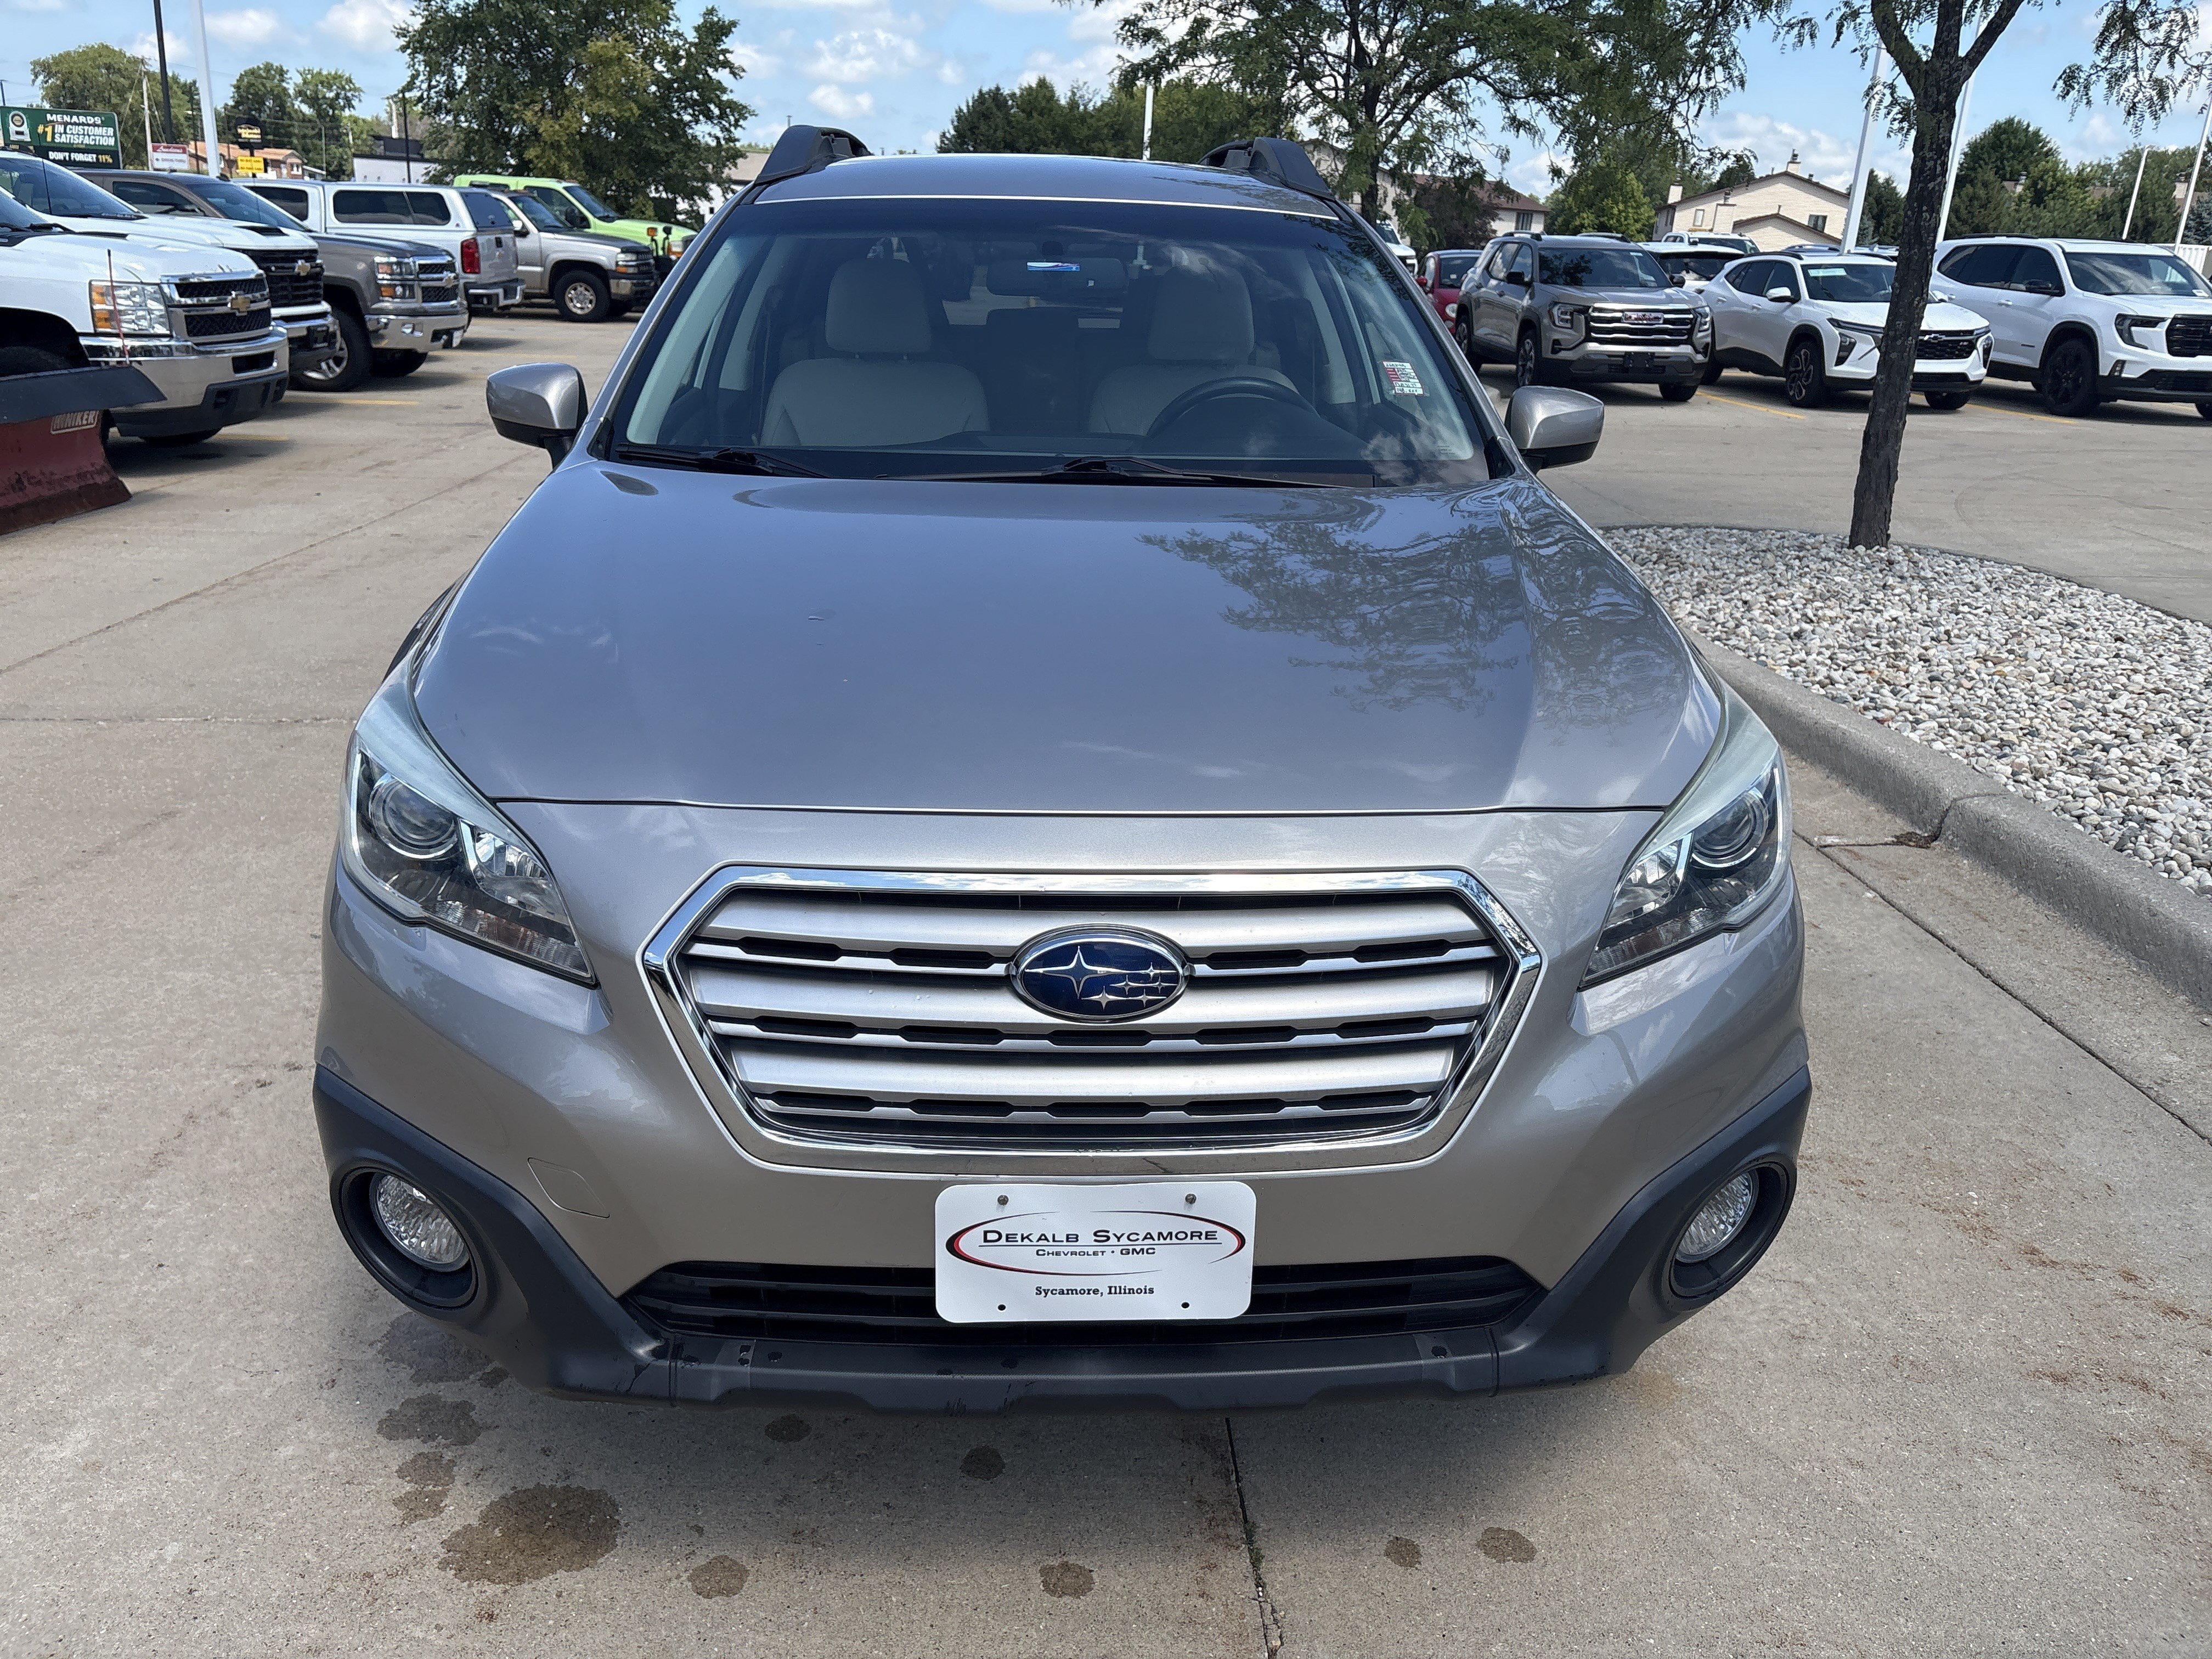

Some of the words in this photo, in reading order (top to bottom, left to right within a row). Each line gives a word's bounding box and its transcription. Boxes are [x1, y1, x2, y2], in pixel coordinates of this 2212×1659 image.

[46, 114, 101, 125] MENARDS
[37, 124, 53, 143] #1
[55, 125, 64, 133] IN
[66, 125, 114, 136] CUSTOMER
[54, 134, 115, 146] SATISFACTION
[48, 151, 70, 161] DON'T
[71, 151, 97, 163] FORGET
[98, 154, 113, 163] 11%
[983, 1229, 1079, 1243] DEKALB
[1093, 1229, 1218, 1243] SYCAMORE
[1120, 1247, 1156, 1256] GMC
[1035, 1286, 1103, 1298] Sycamore,
[1108, 1285, 1155, 1295] Illinois
